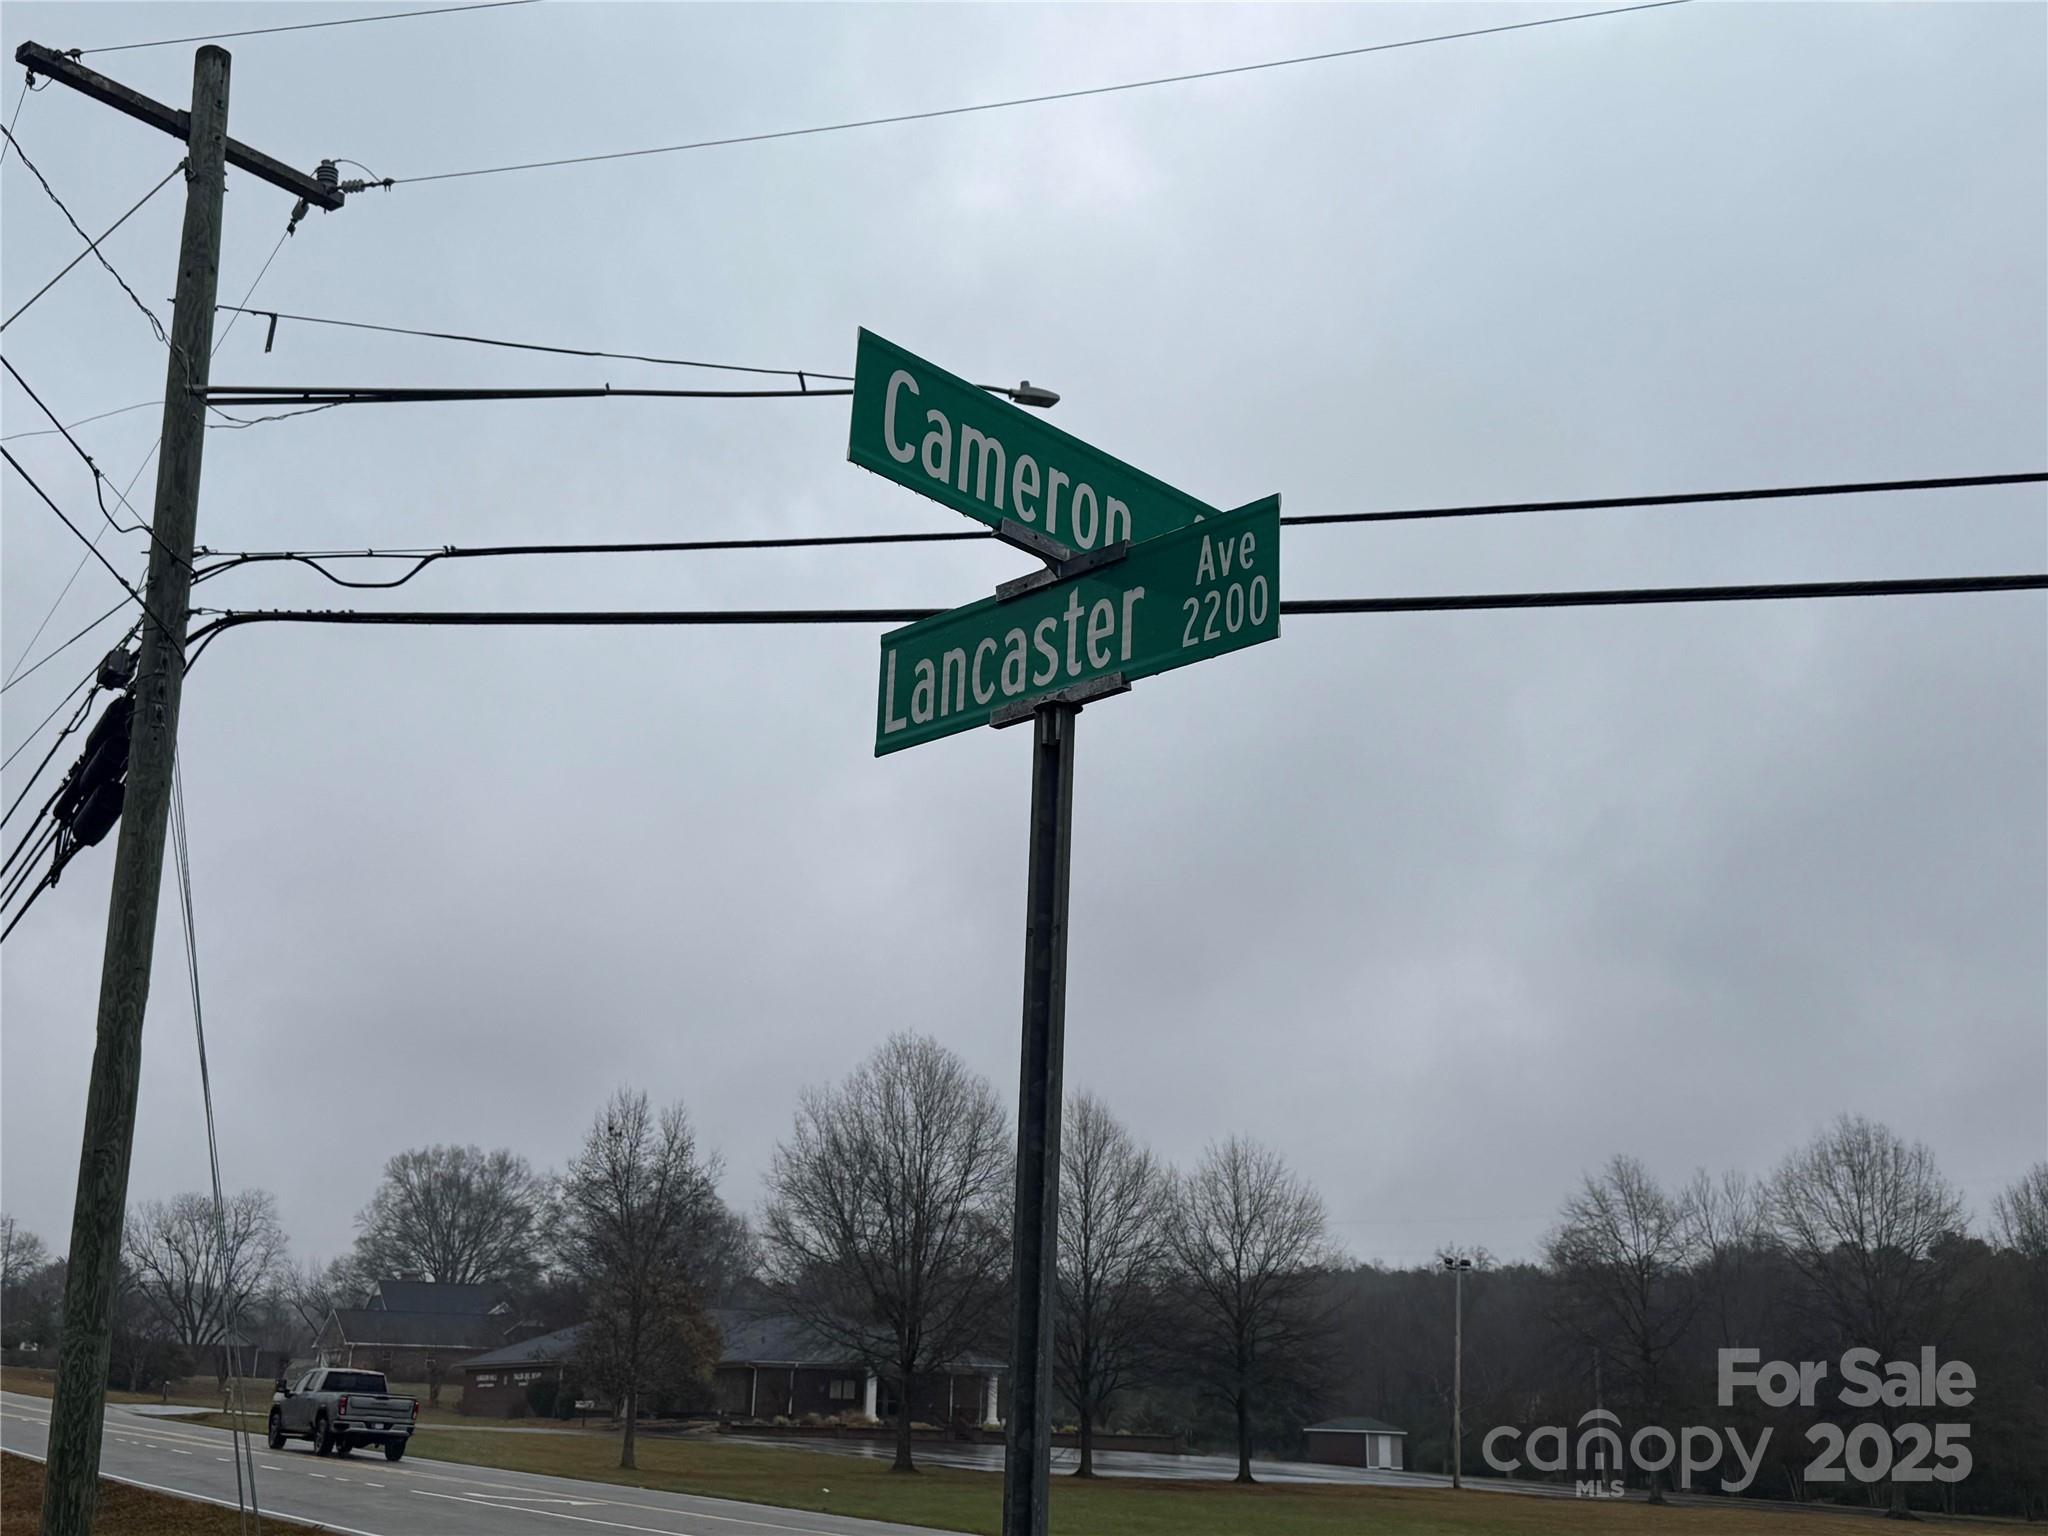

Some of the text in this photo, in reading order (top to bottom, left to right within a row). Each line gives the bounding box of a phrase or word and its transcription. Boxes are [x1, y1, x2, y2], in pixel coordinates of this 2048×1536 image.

[884, 370, 1132, 550] Cameron
[1182, 575, 1268, 648] 2200
[1195, 531, 1256, 586] Ave
[884, 586, 1145, 734] Lancaster
